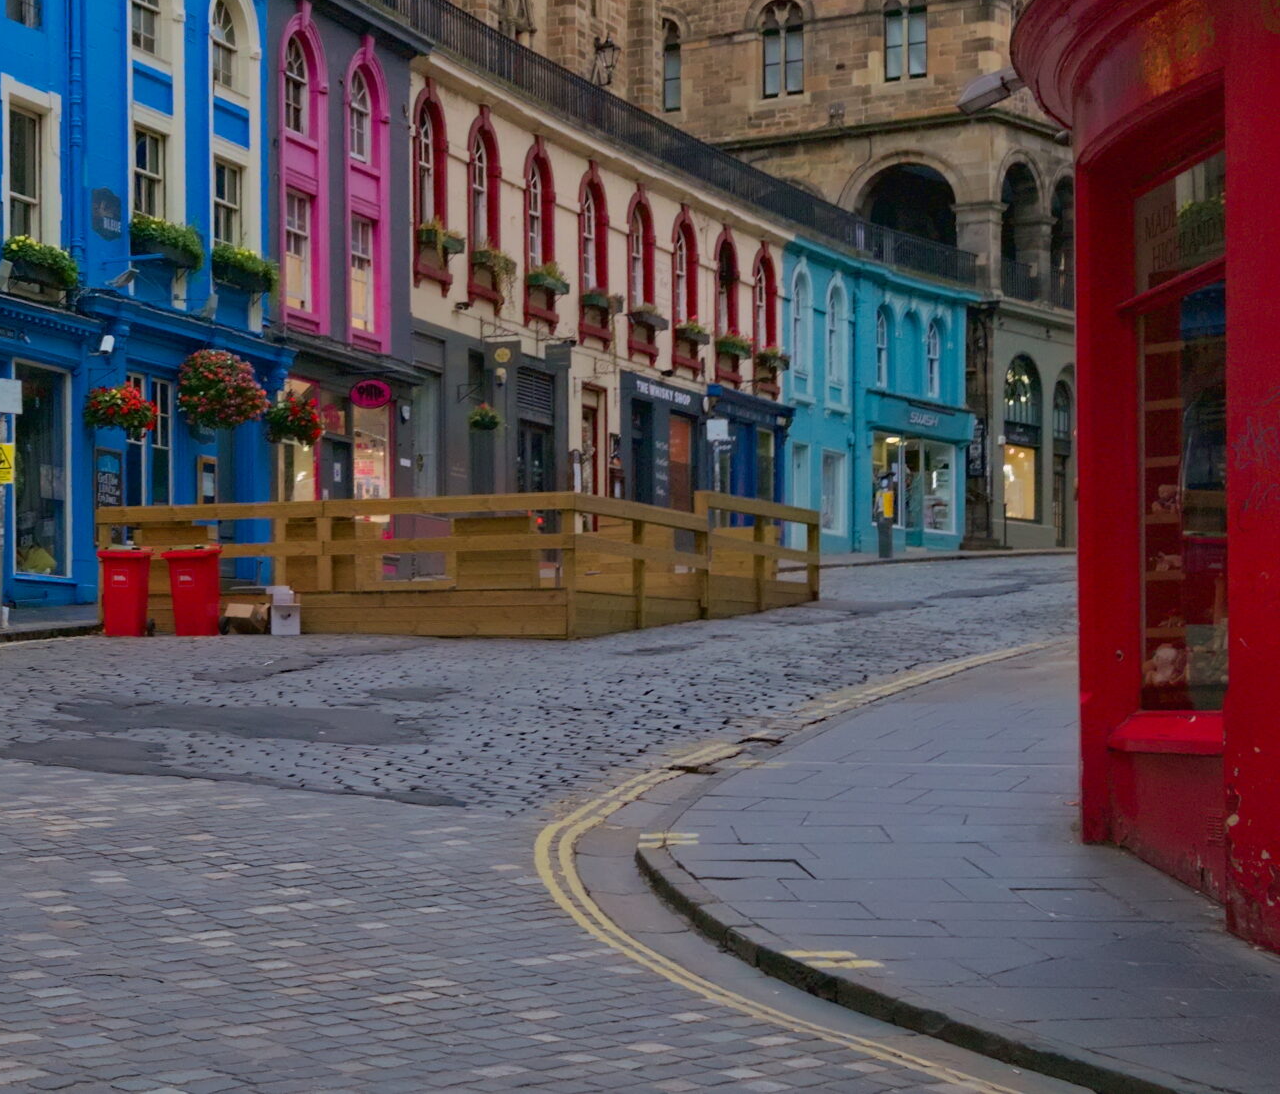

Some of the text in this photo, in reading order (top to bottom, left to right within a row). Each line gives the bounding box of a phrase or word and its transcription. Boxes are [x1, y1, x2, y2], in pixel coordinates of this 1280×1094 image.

[636, 379, 691, 406] THE WHISKY SHOP
